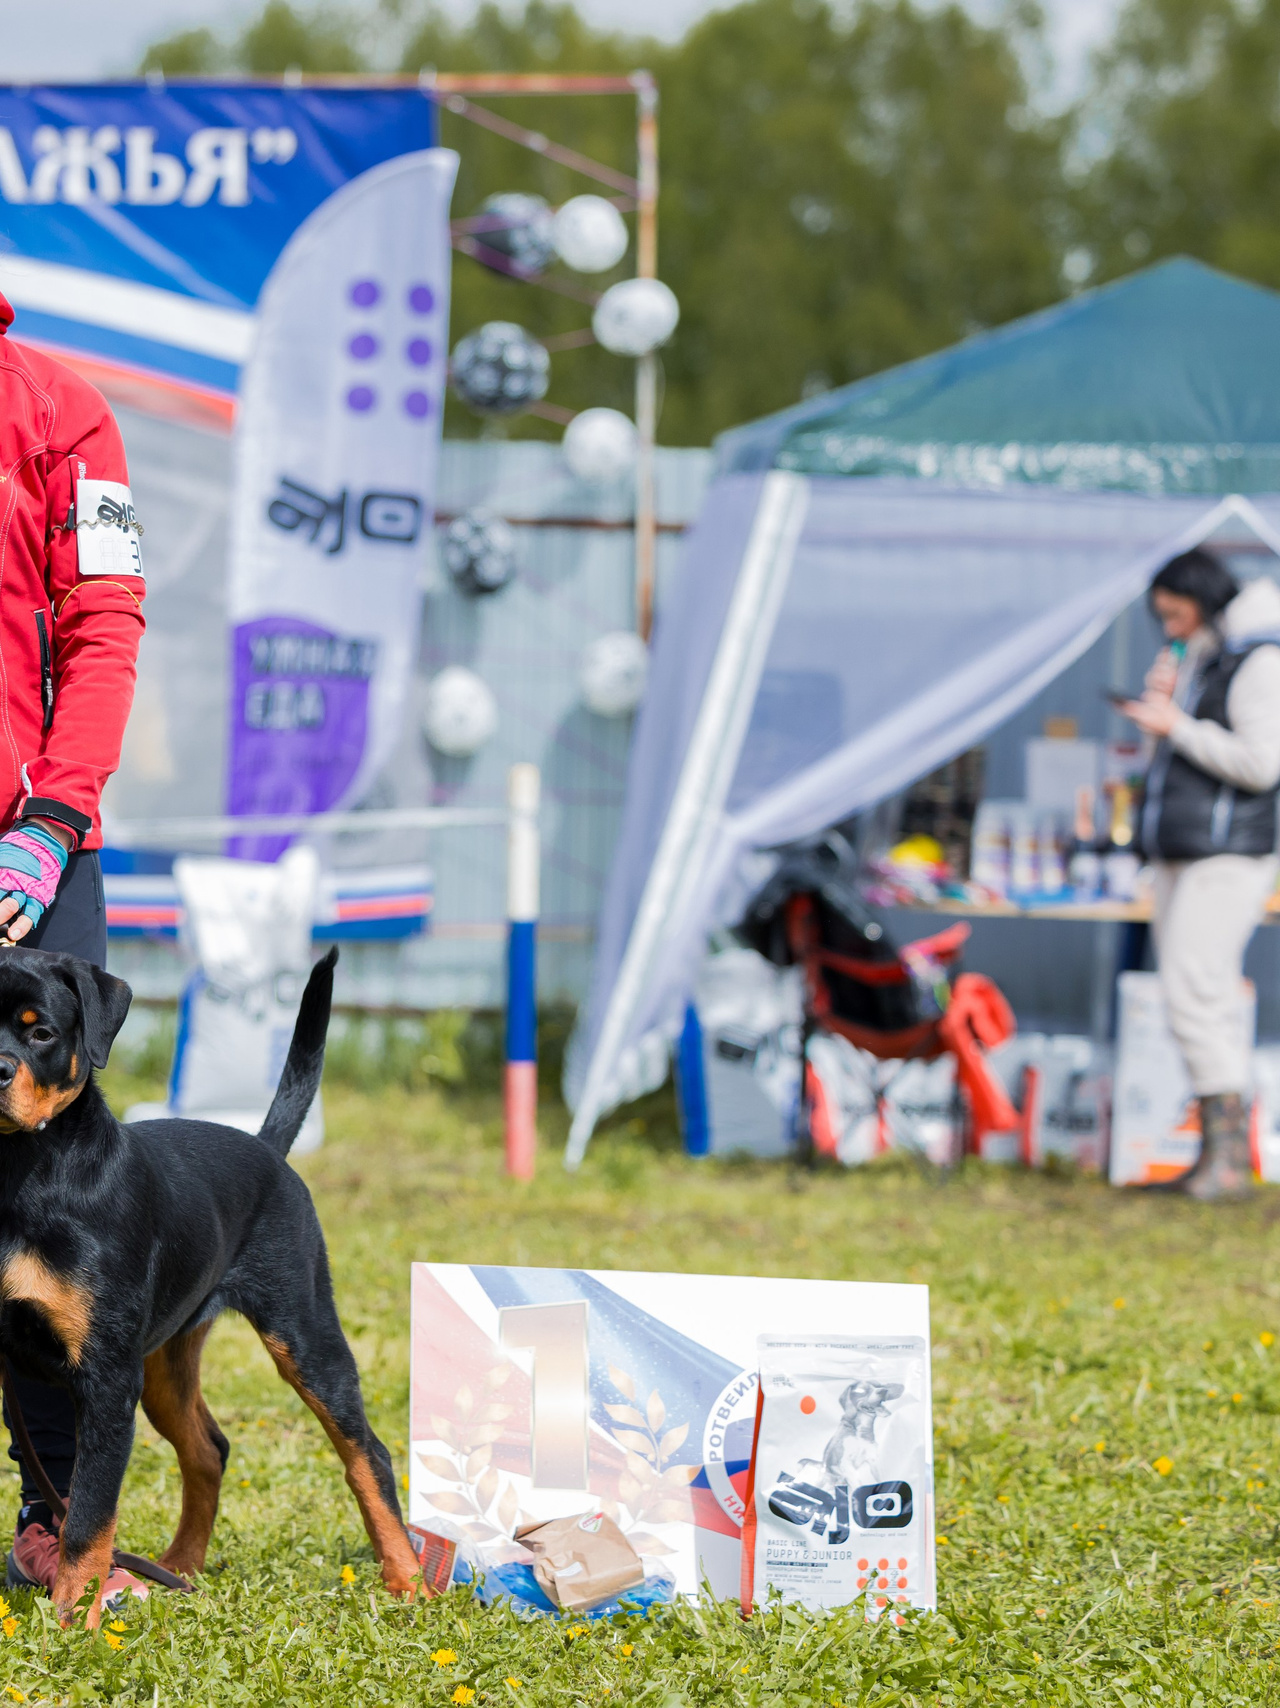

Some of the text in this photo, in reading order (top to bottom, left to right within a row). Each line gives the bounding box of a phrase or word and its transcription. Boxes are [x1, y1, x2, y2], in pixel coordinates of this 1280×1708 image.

[709, 1371, 759, 1463] РОТВЕЙЛ
[767, 1539, 788, 1547] BASIC
[766, 1549, 853, 1560] PUPPY & JUNIOR
